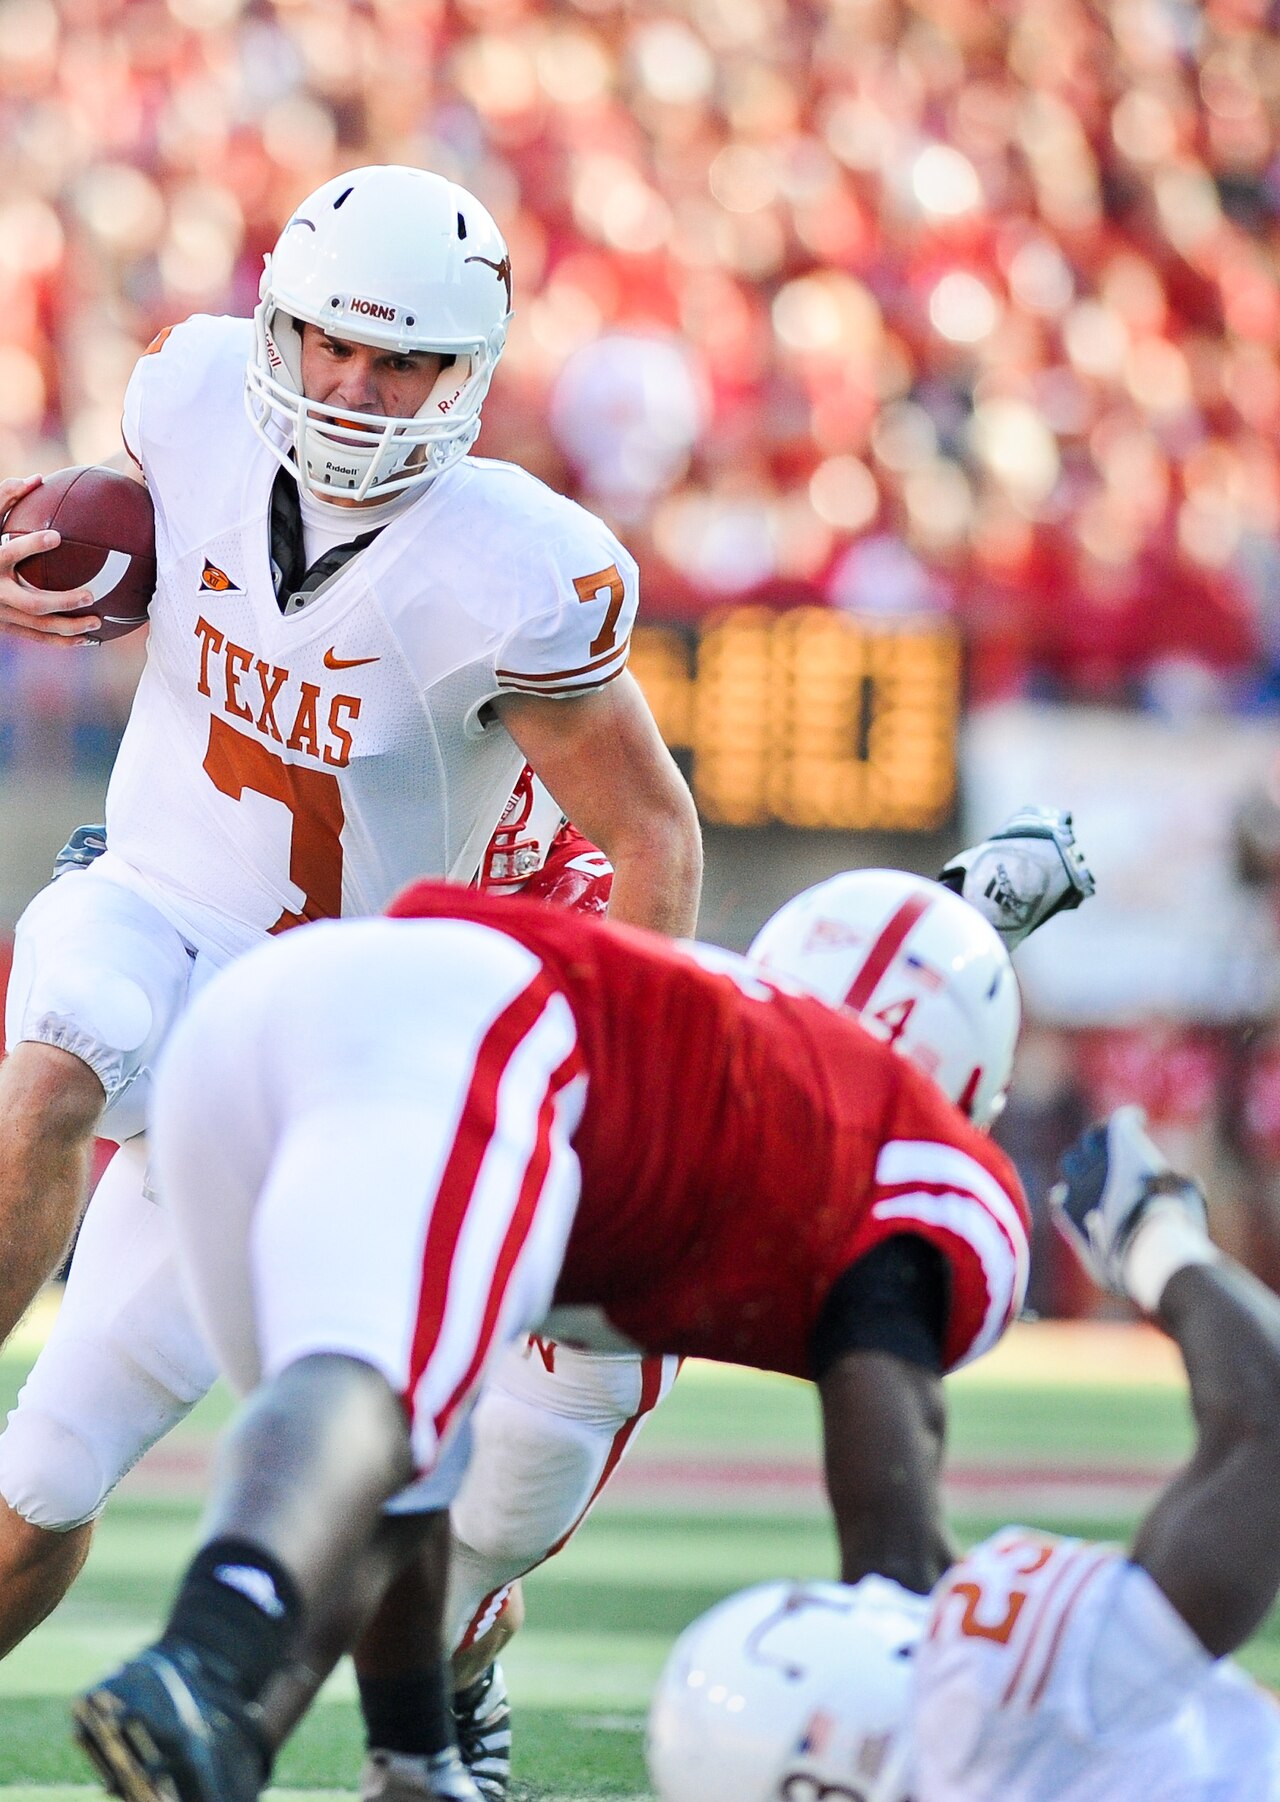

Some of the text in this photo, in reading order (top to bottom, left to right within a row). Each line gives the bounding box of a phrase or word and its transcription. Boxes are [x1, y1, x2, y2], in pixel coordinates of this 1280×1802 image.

[350, 297, 396, 322] HORNS
[325, 461, 359, 477] Riddell
[572, 564, 625, 659] 7
[194, 614, 362, 769] TEXAS
[202, 712, 345, 937] 7
